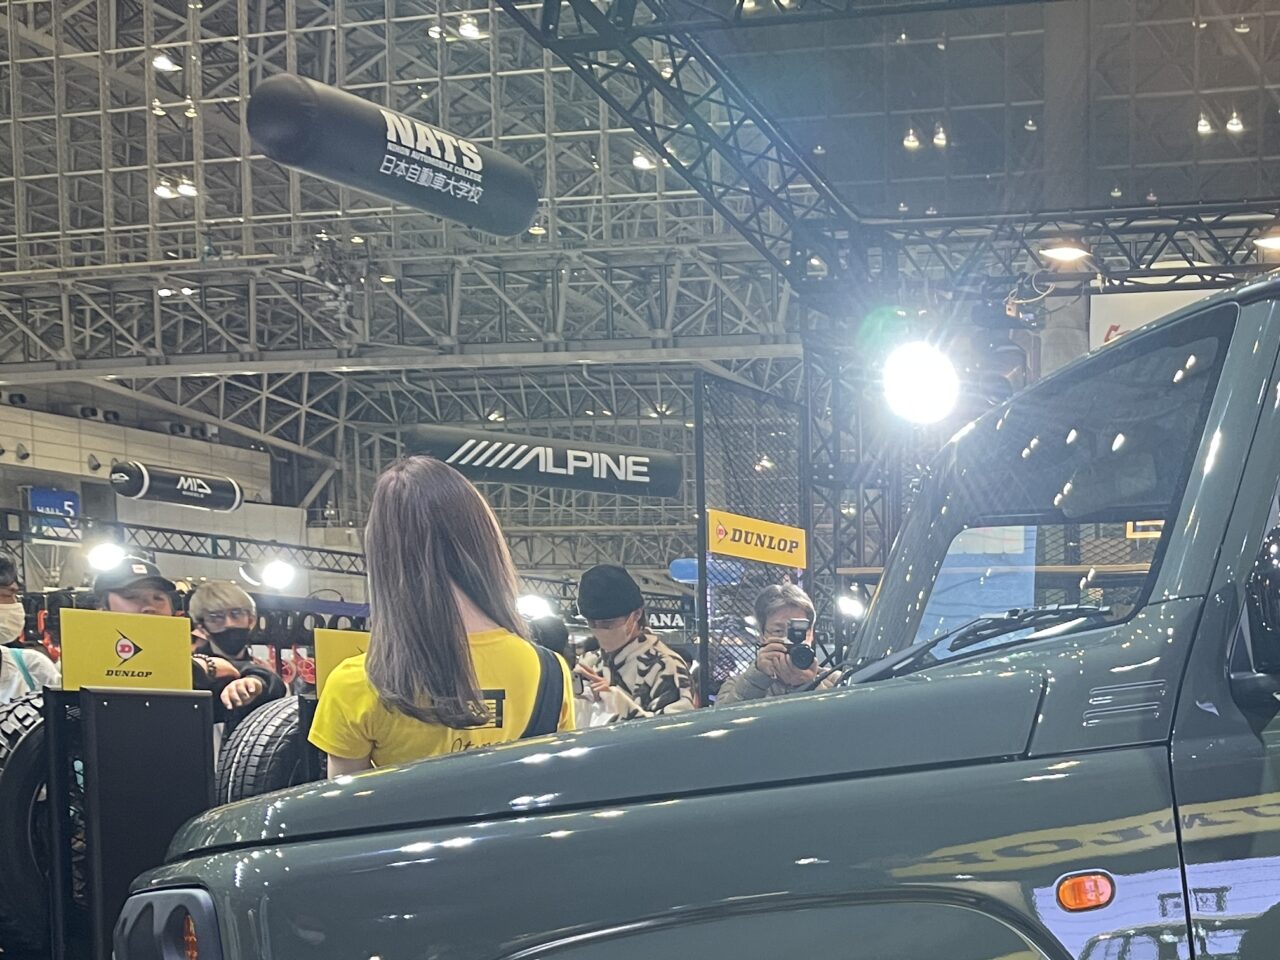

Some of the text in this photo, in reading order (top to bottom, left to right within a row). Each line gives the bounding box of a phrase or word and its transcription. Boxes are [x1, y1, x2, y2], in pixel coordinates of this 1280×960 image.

[380, 109, 483, 172] NATS
[379, 154, 484, 204] 日本自動車大学校
[512, 445, 650, 483] ALPINE
[729, 527, 800, 555] DUNLOP
[105, 669, 153, 679] DUNLOP
